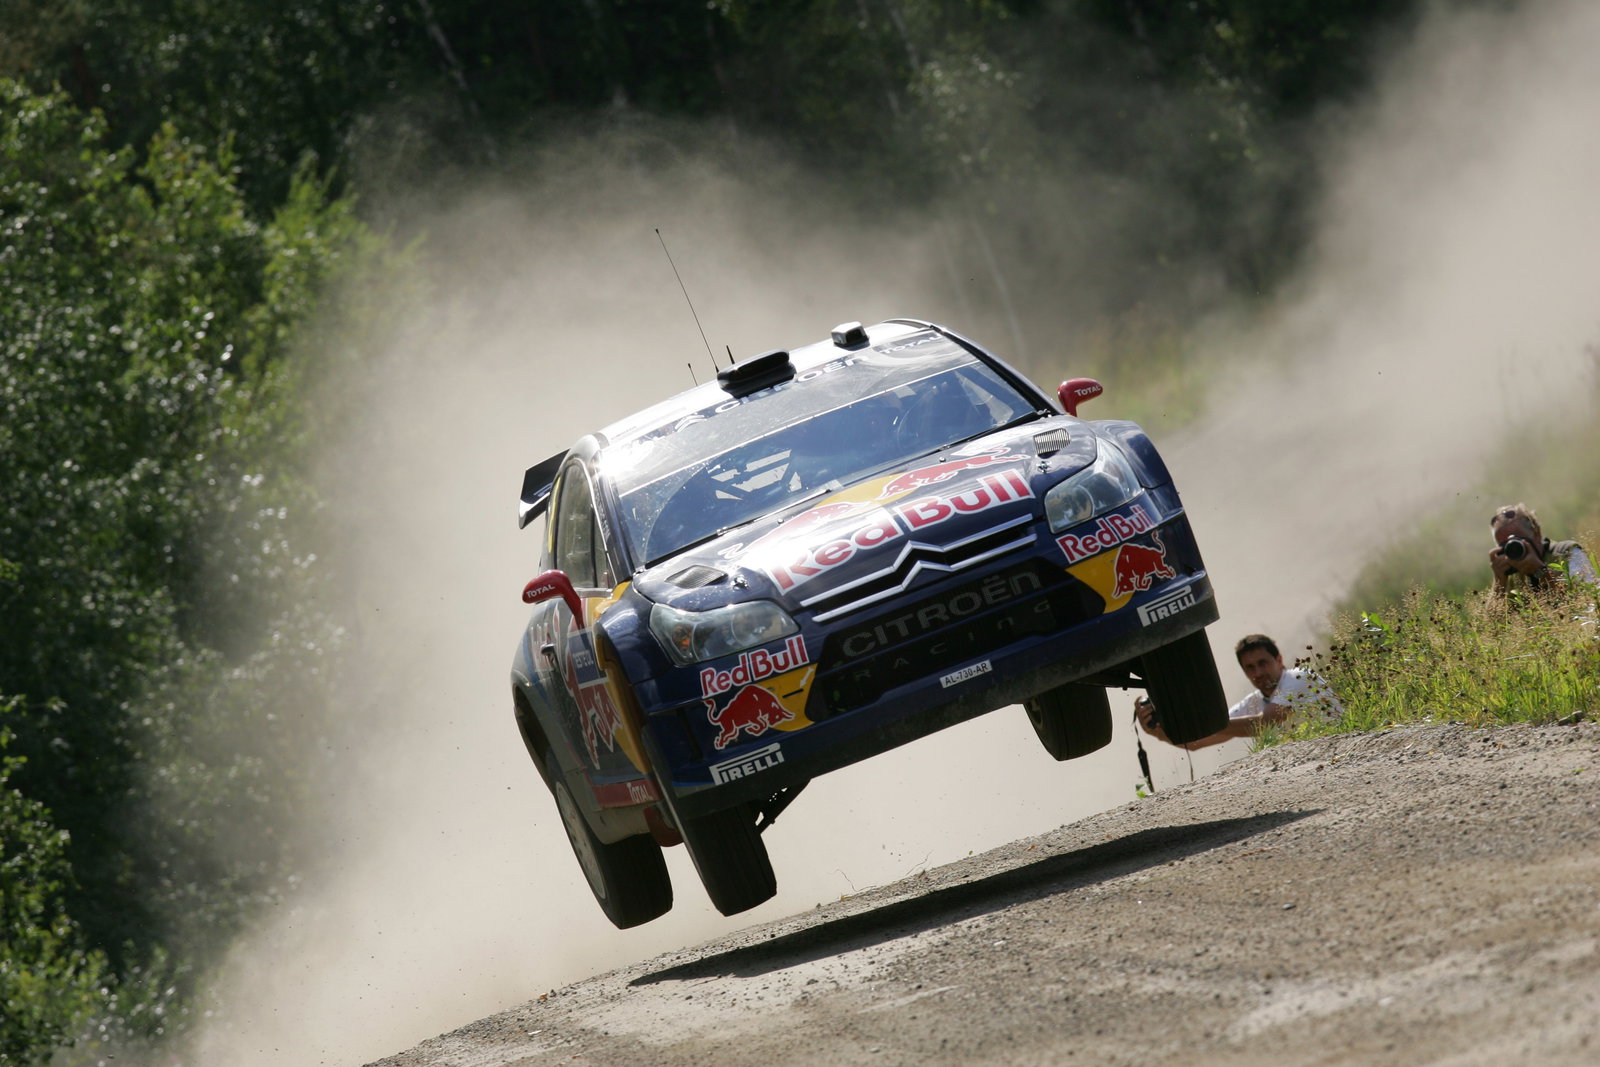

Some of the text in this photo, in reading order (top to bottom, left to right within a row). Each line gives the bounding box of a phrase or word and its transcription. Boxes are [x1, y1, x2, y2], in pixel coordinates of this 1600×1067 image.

[1074, 385, 1101, 396] TOTAL
[767, 469, 1036, 596] Red Bull
[526, 584, 555, 598] TOTAL
[1136, 585, 1196, 627] PIRELLI
[944, 661, 989, 686] AL-730-AR
[709, 742, 785, 786] PIRELLI
